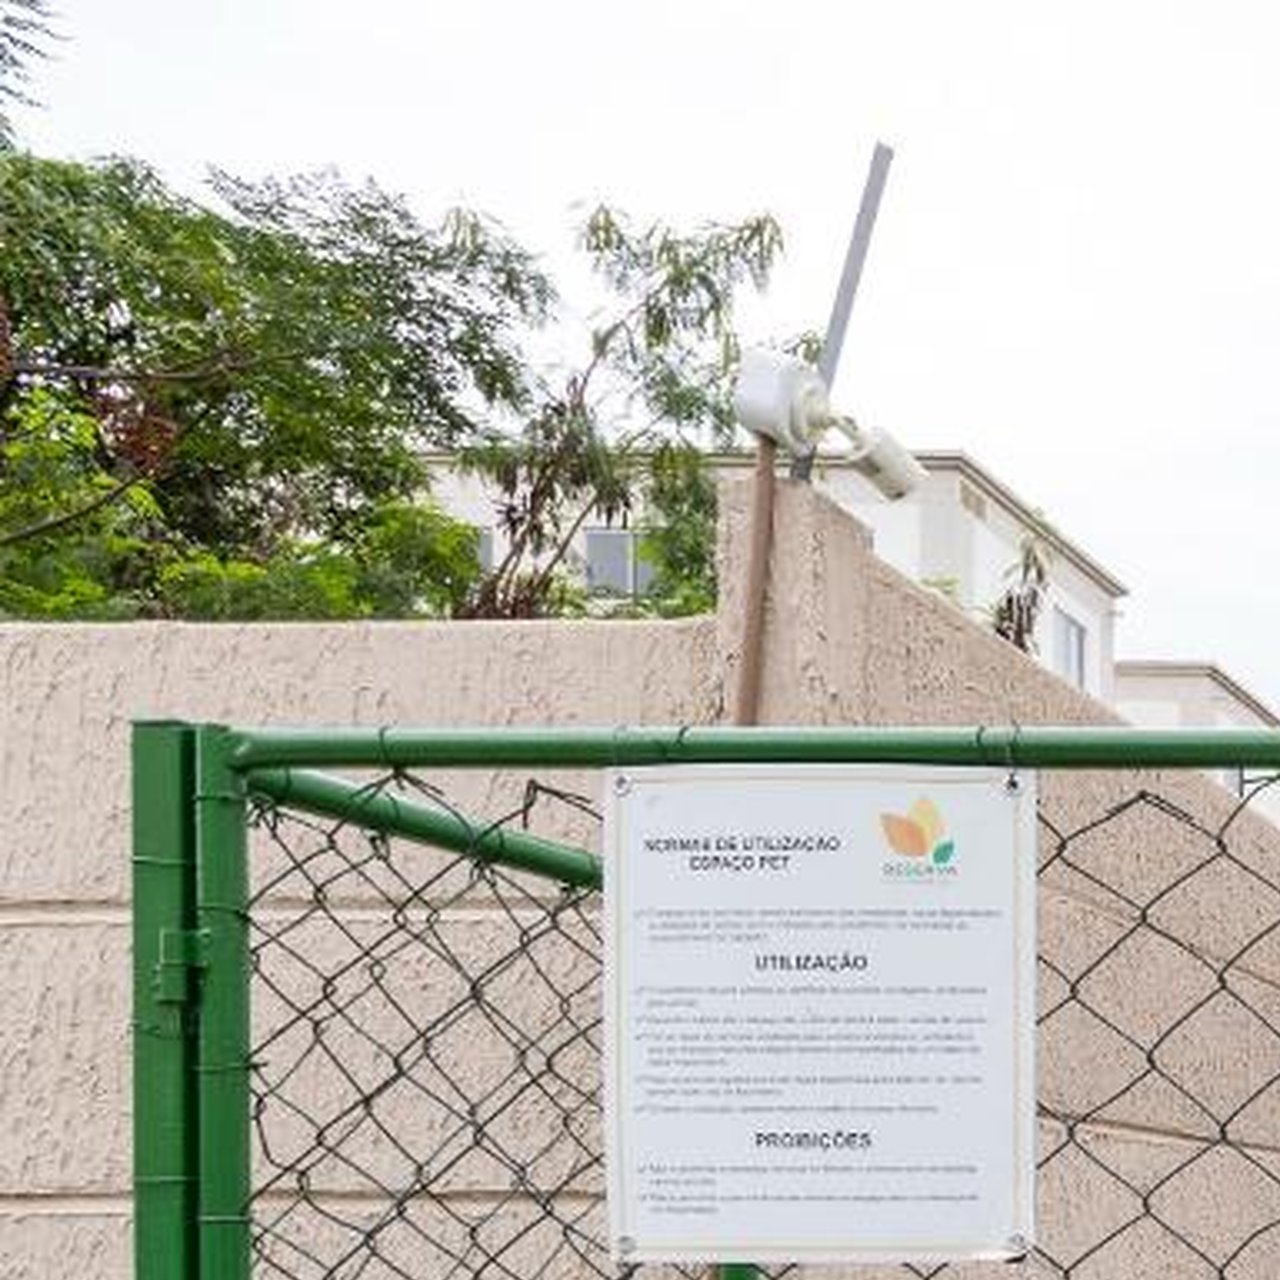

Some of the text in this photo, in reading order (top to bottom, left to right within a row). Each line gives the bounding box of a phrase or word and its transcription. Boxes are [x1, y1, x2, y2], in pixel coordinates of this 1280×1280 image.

[643, 833, 841, 854] NORMAS DE UTILIZAÇÃO
[755, 951, 868, 972] UTILIZAÇÃO
[755, 1127, 873, 1151] PROIBIÇÕES
